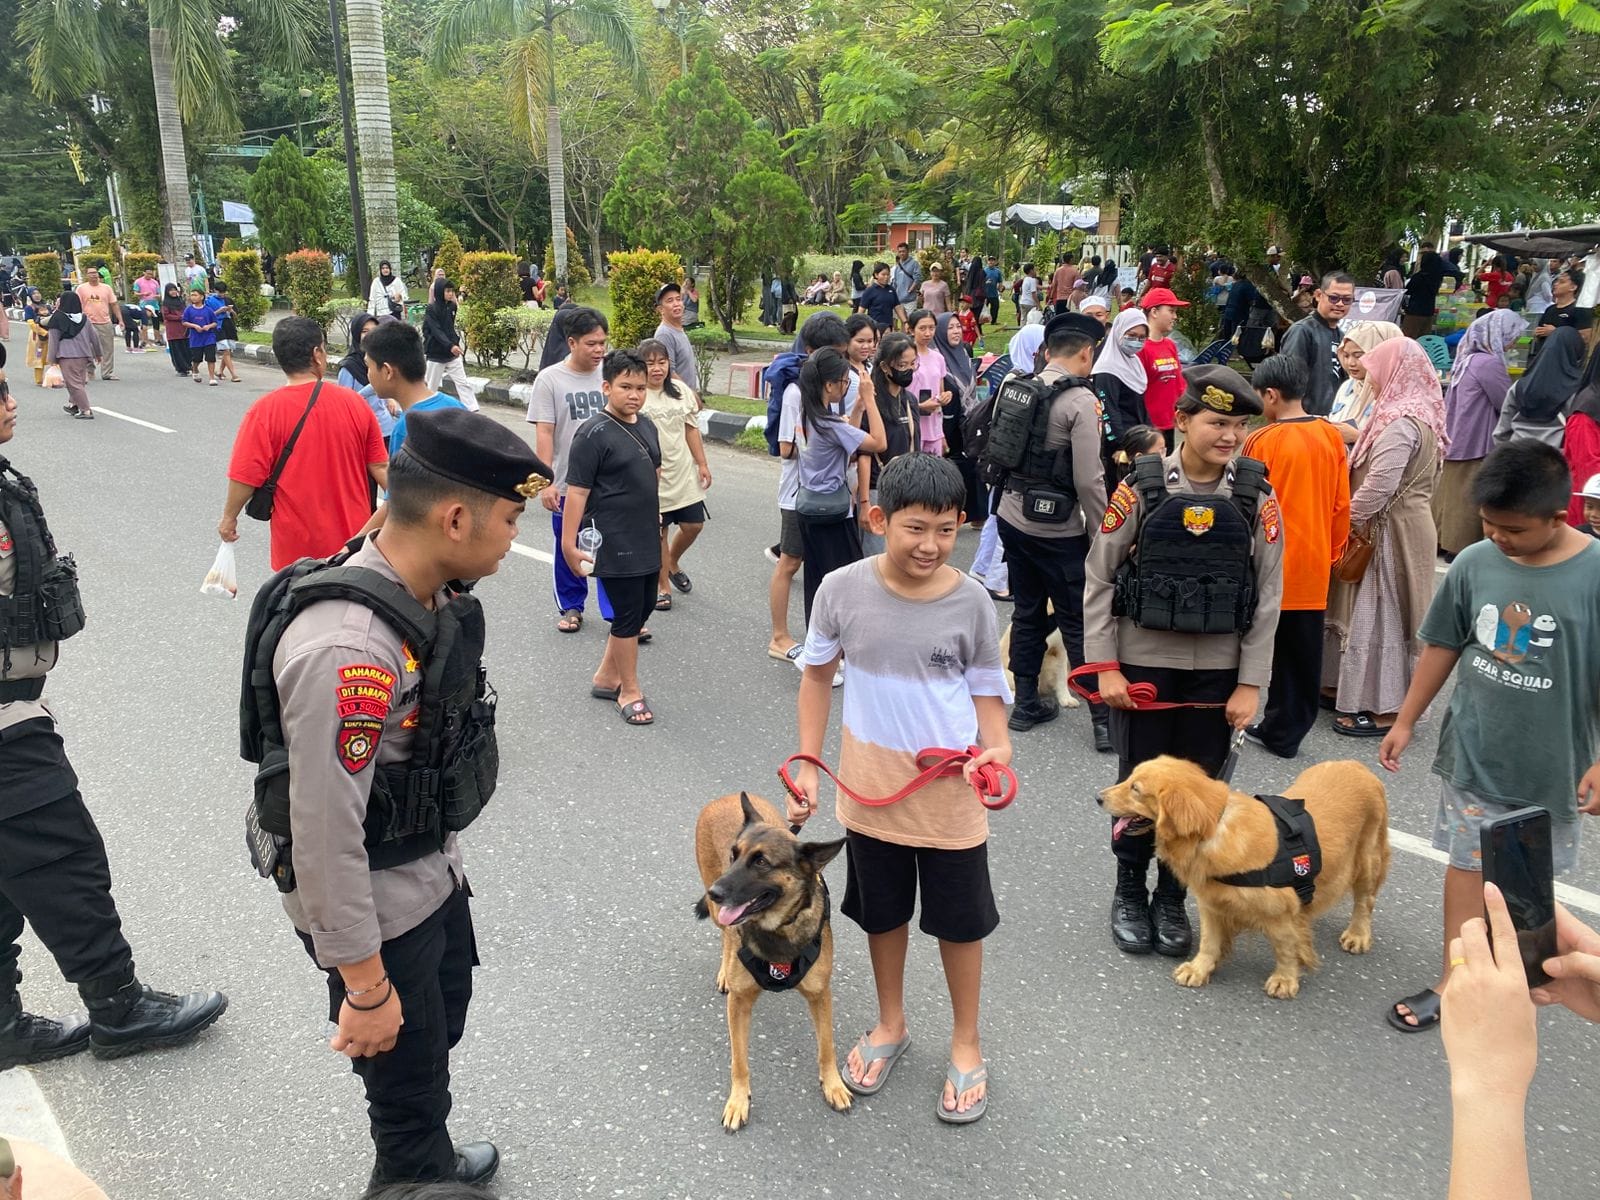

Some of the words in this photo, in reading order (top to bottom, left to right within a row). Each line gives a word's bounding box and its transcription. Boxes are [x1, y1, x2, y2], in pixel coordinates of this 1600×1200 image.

[1086, 235, 1119, 244] HOTEL
[1004, 387, 1031, 405] POLISI
[1472, 656, 1498, 677] BEAR
[1501, 670, 1553, 690] SQUAD
[341, 687, 355, 697] DIT
[342, 703, 356, 714] K9
[358, 702, 385, 717] SQUAD
